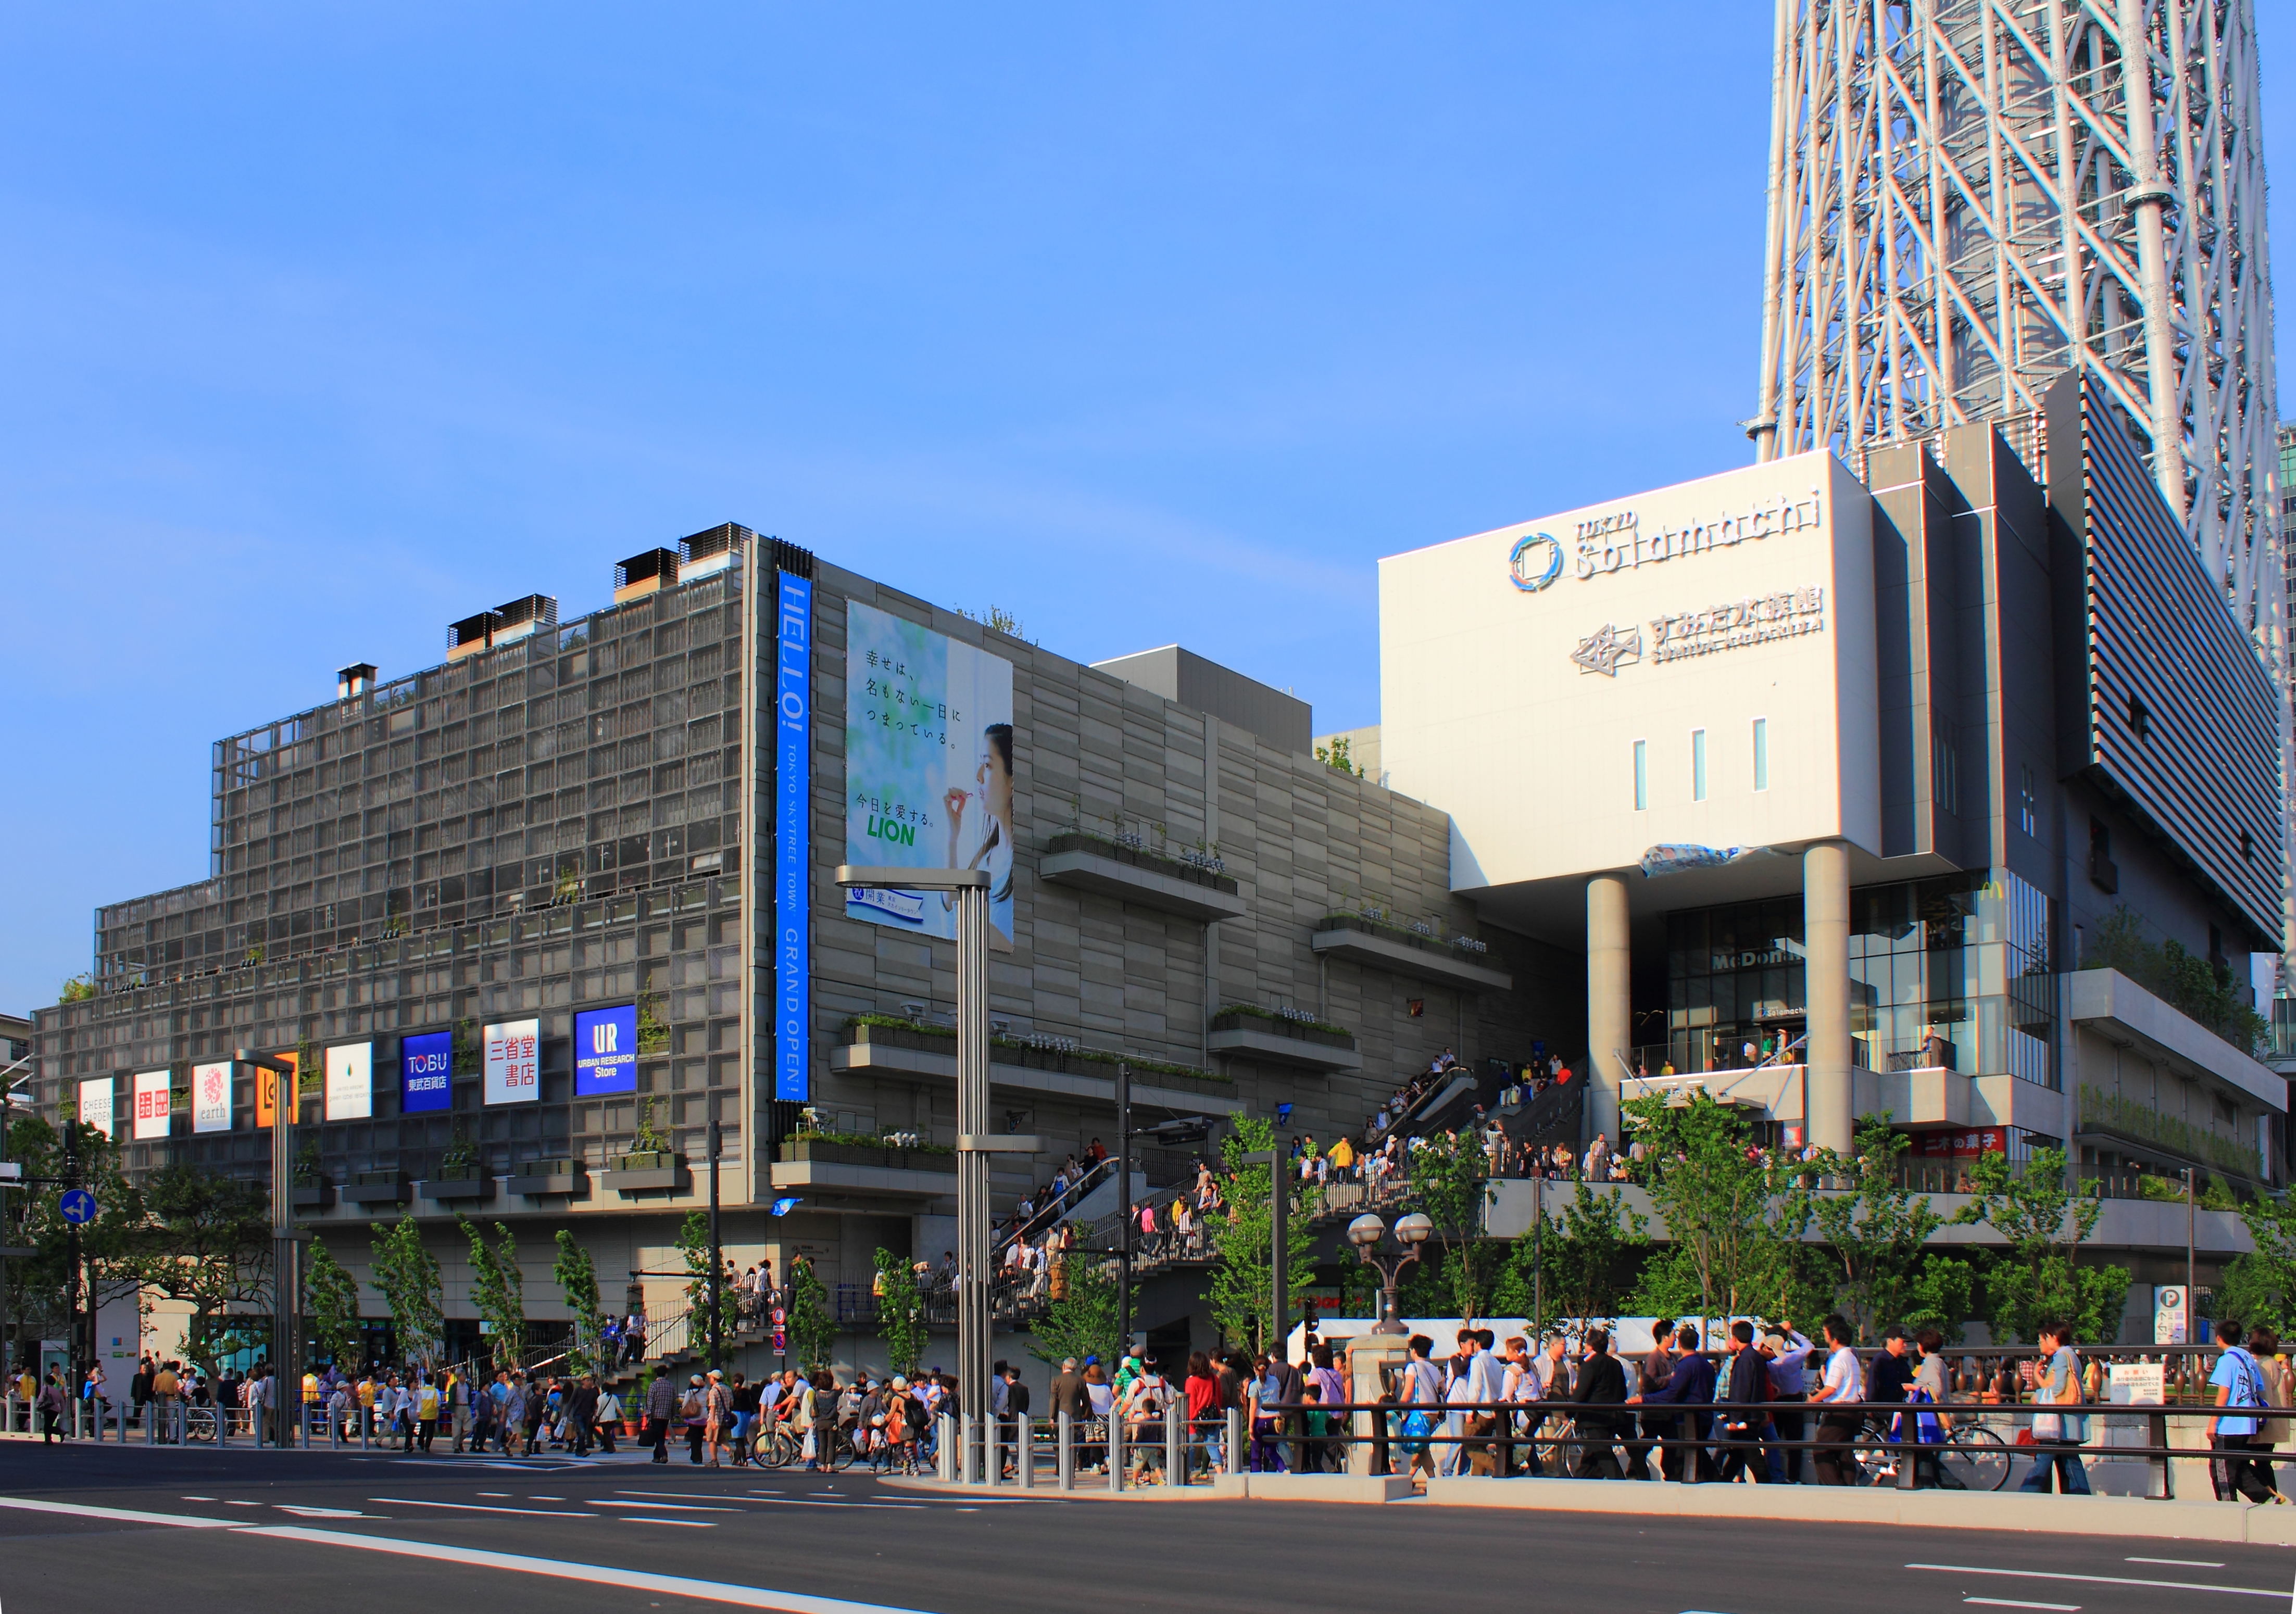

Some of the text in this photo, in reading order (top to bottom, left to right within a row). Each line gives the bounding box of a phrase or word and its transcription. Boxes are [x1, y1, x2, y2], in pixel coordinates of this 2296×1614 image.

[1573, 511, 1639, 540] TOKYO
[1573, 485, 1821, 580] Solamachi
[1649, 584, 1823, 645] すみだ水族館
[1651, 616, 1823, 665] SUMIDA AQUARIUM
[782, 585, 806, 732] HELLO!
[866, 650, 913, 681] 幸せは、
[866, 678, 960, 722] 名もない一日に
[867, 710, 955, 749] つまっている。
[788, 745, 796, 793] TOKYO
[856, 793, 933, 827] 今日を愛する。
[788, 800, 796, 864] SKYTREE
[867, 814, 915, 847] LION
[785, 928, 798, 1013] GRAND
[491, 1035, 535, 1061] 三省堂
[594, 1023, 618, 1053] UR
[408, 1053, 447, 1073] TOBU
[578, 1053, 635, 1068] URBAN RESEARCH
[786, 1019, 799, 1093] OPEN!
[408, 1075, 447, 1092] 東武百貨店
[505, 1062, 535, 1087] 書店
[595, 1066, 617, 1078] Store
[83, 1098, 111, 1111] CHEESE
[83, 1112, 112, 1123] GARDEN
[201, 1103, 226, 1119] earth
[1925, 1133, 1997, 1151] 二木の菓子
[2165, 1291, 2177, 1306] P
